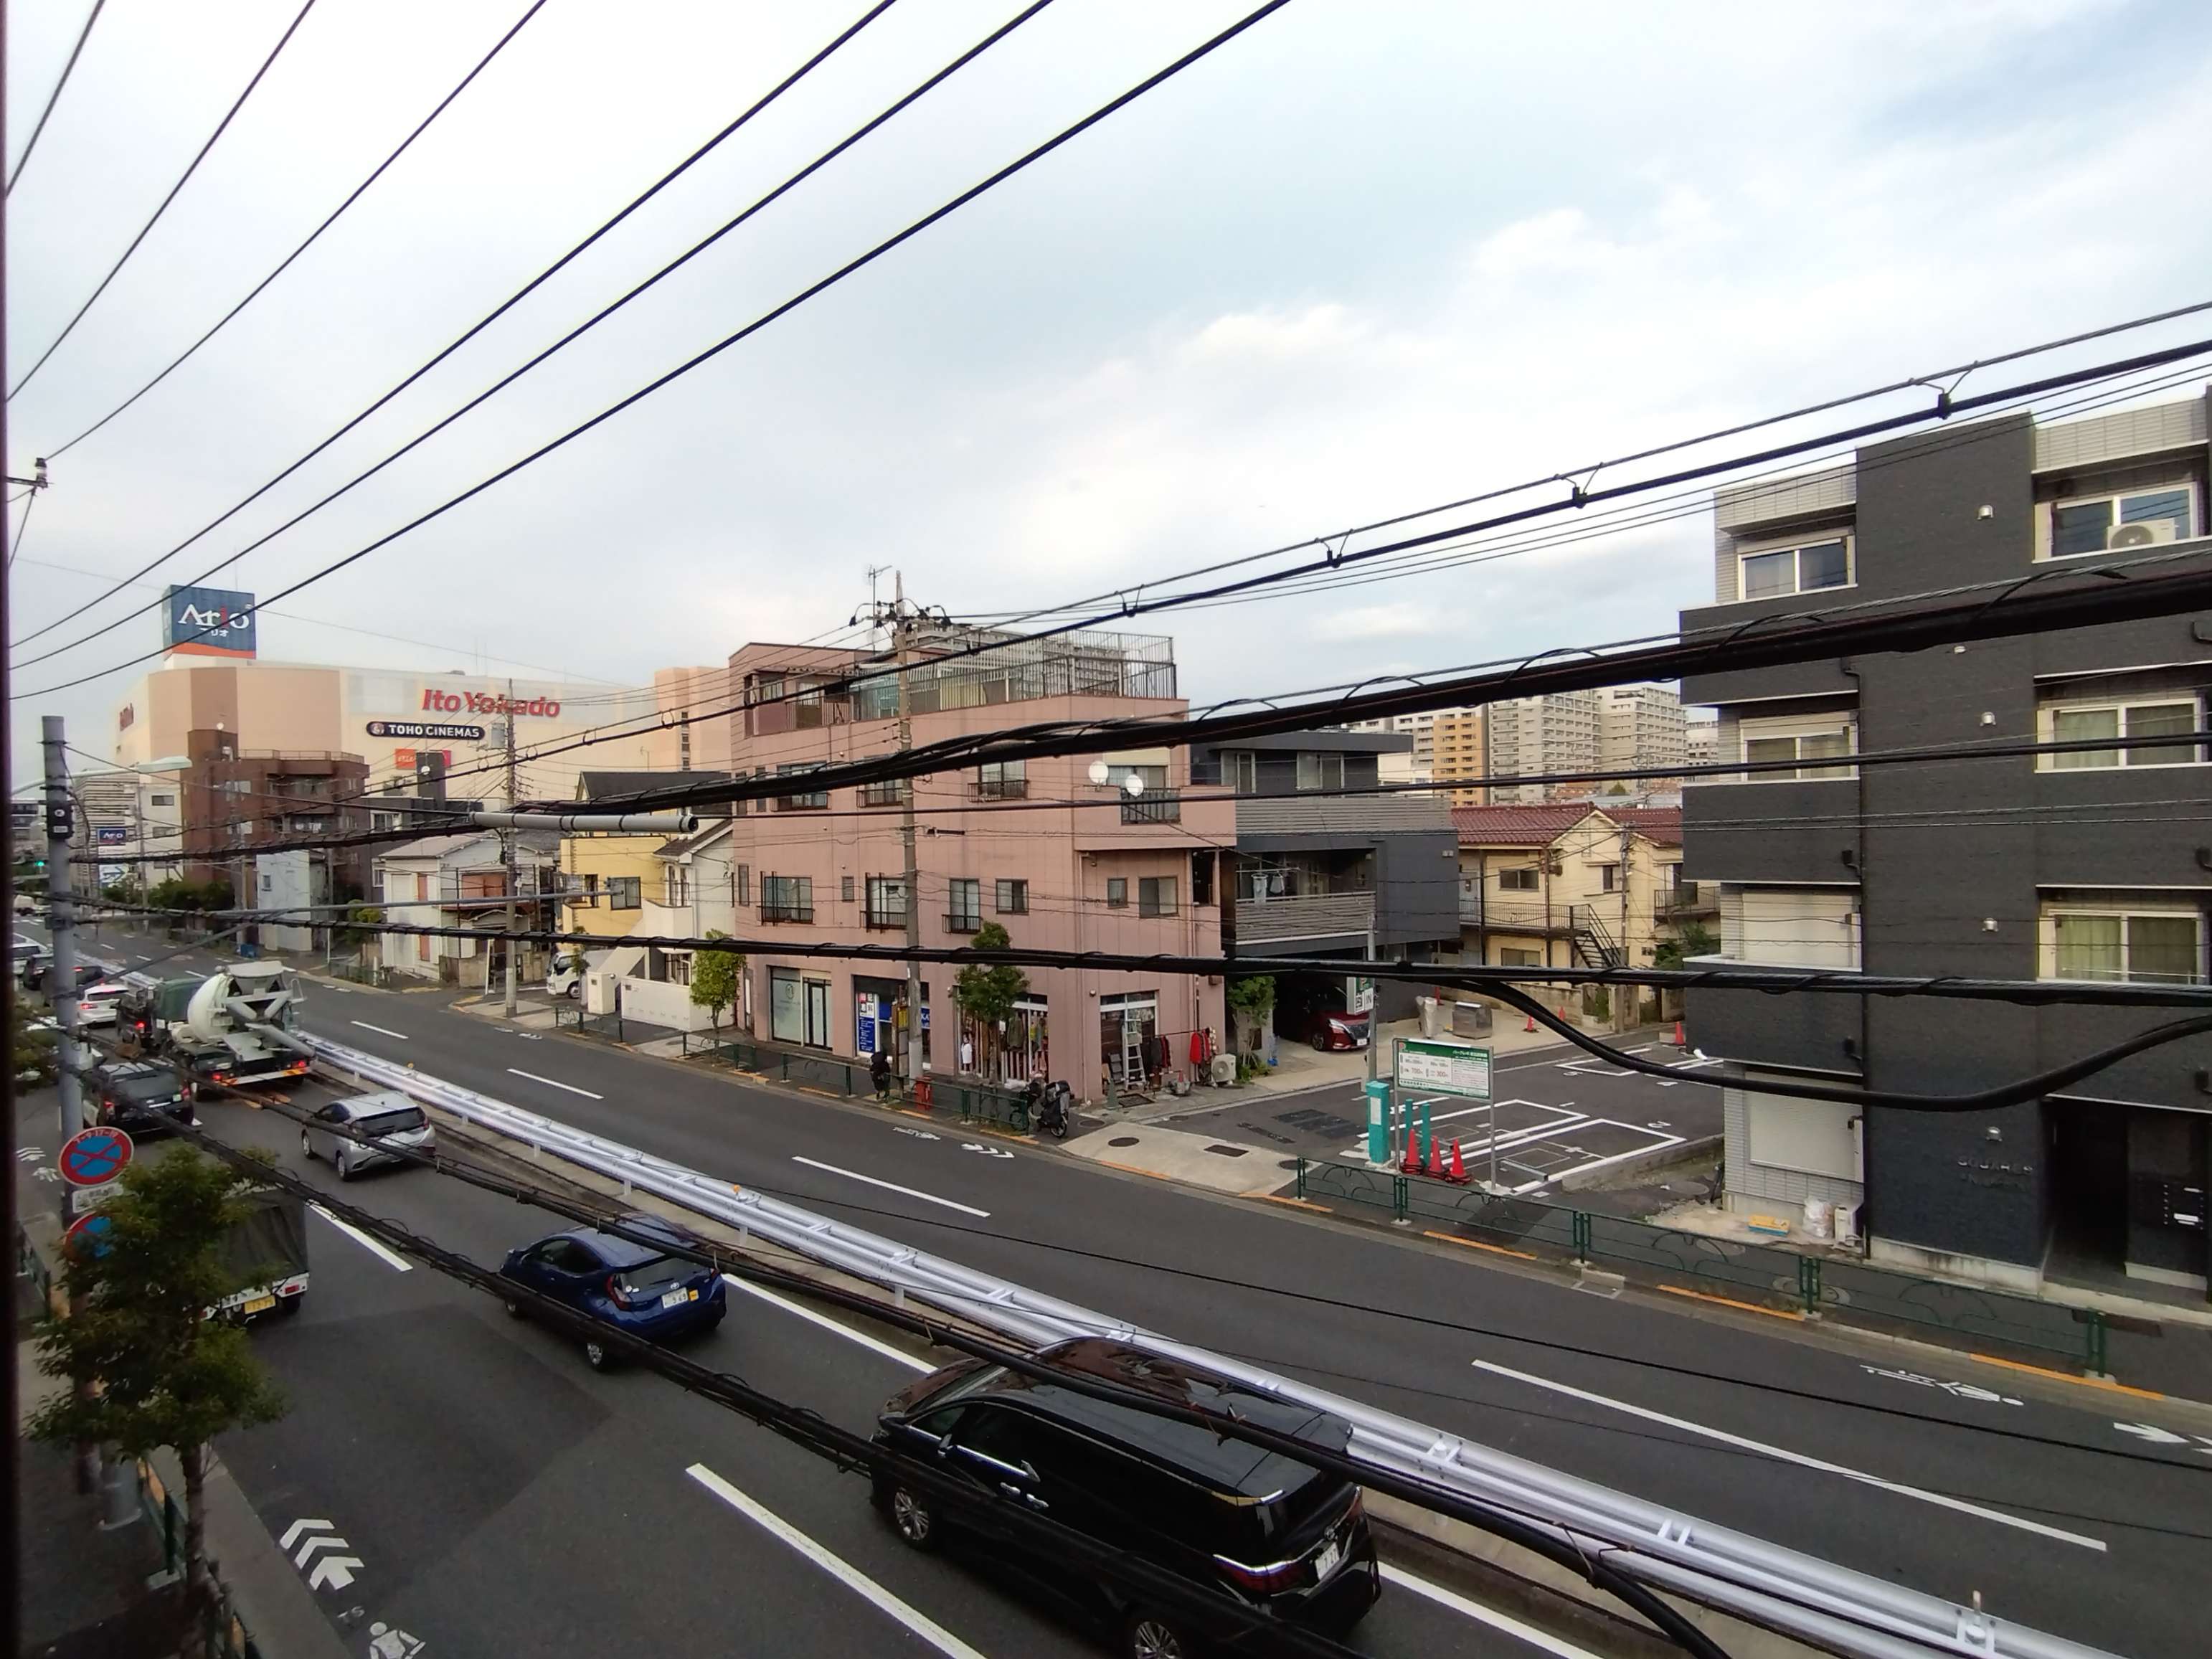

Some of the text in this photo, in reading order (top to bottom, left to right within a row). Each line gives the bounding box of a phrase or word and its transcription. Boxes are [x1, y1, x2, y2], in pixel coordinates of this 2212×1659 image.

[178, 604, 250, 629] Ario
[422, 689, 461, 712] Ito
[388, 724, 480, 737] TOHO CINEMAS
